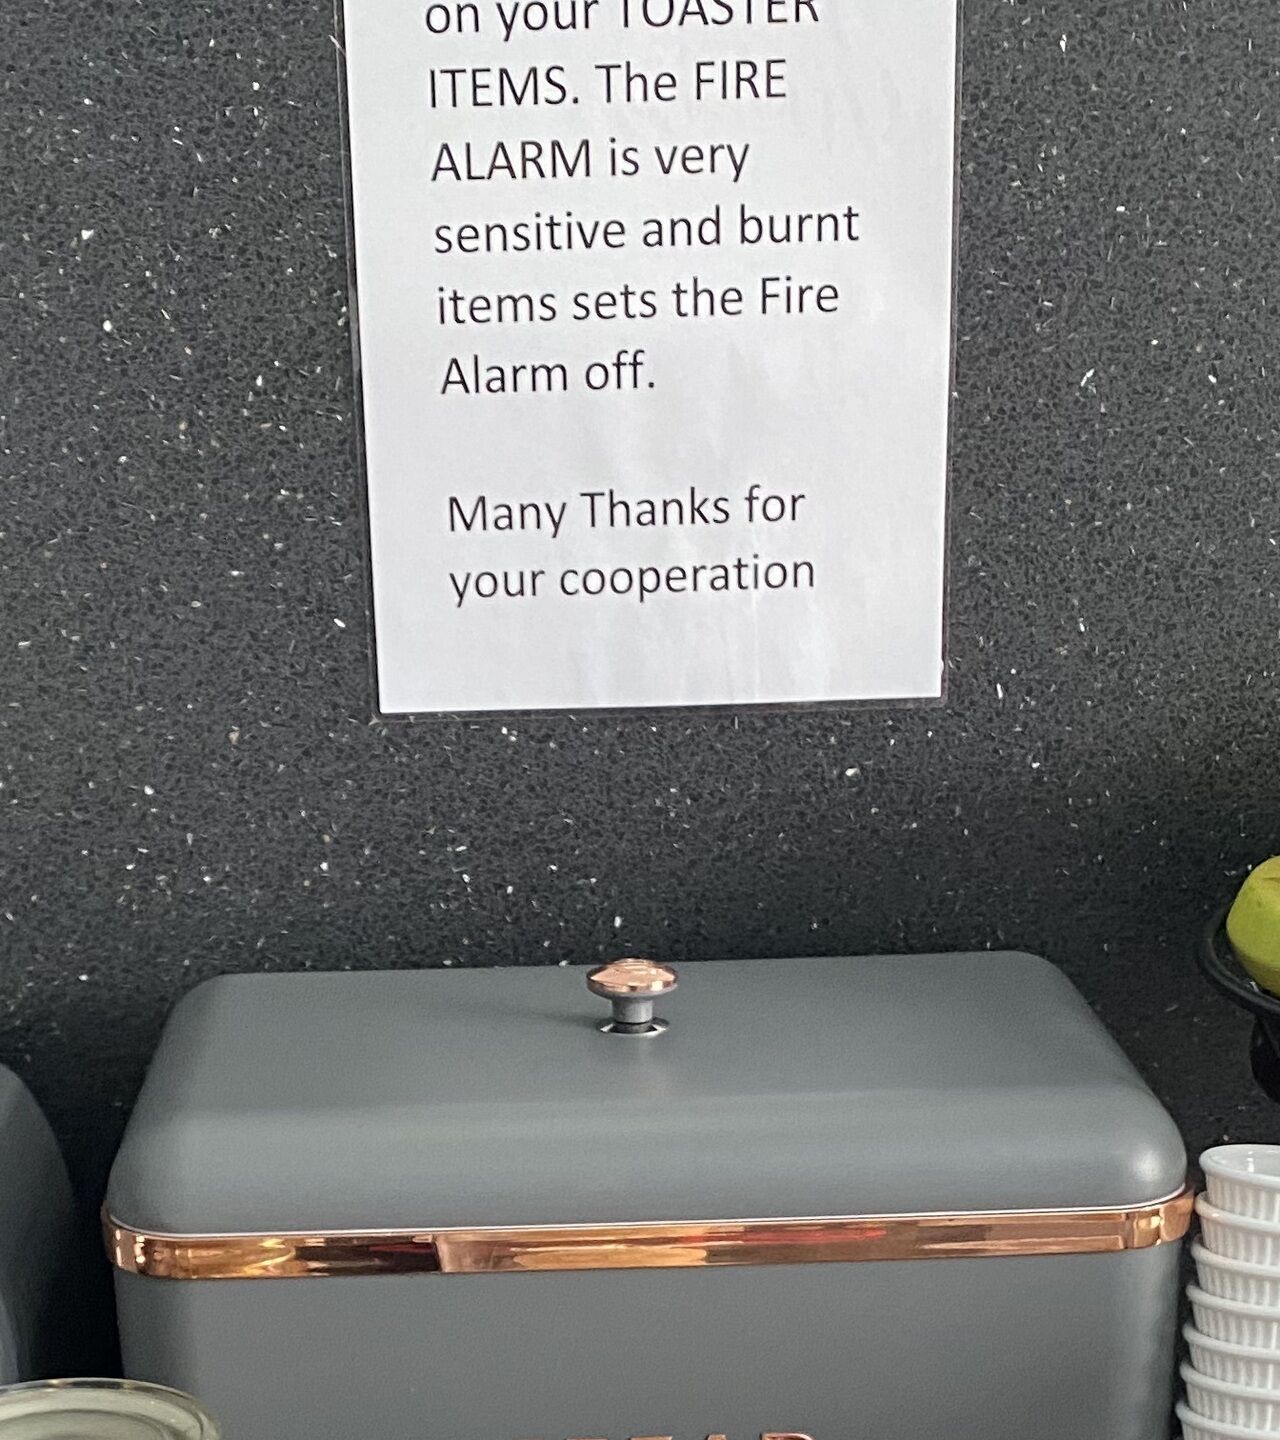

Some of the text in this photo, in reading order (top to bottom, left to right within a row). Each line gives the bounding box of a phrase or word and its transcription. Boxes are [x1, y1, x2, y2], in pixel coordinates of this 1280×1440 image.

[426, 0, 820, 42] on your TOASTER
[430, 59, 786, 108] ITEMS. The FIRE
[432, 138, 749, 182] ALARM is very
[435, 204, 859, 253] sensitive and burnt
[439, 276, 838, 324] items sets the Fire
[441, 350, 654, 394] Alarm off.
[449, 485, 805, 538] Many Thanks for
[450, 554, 813, 608] your cooperation
